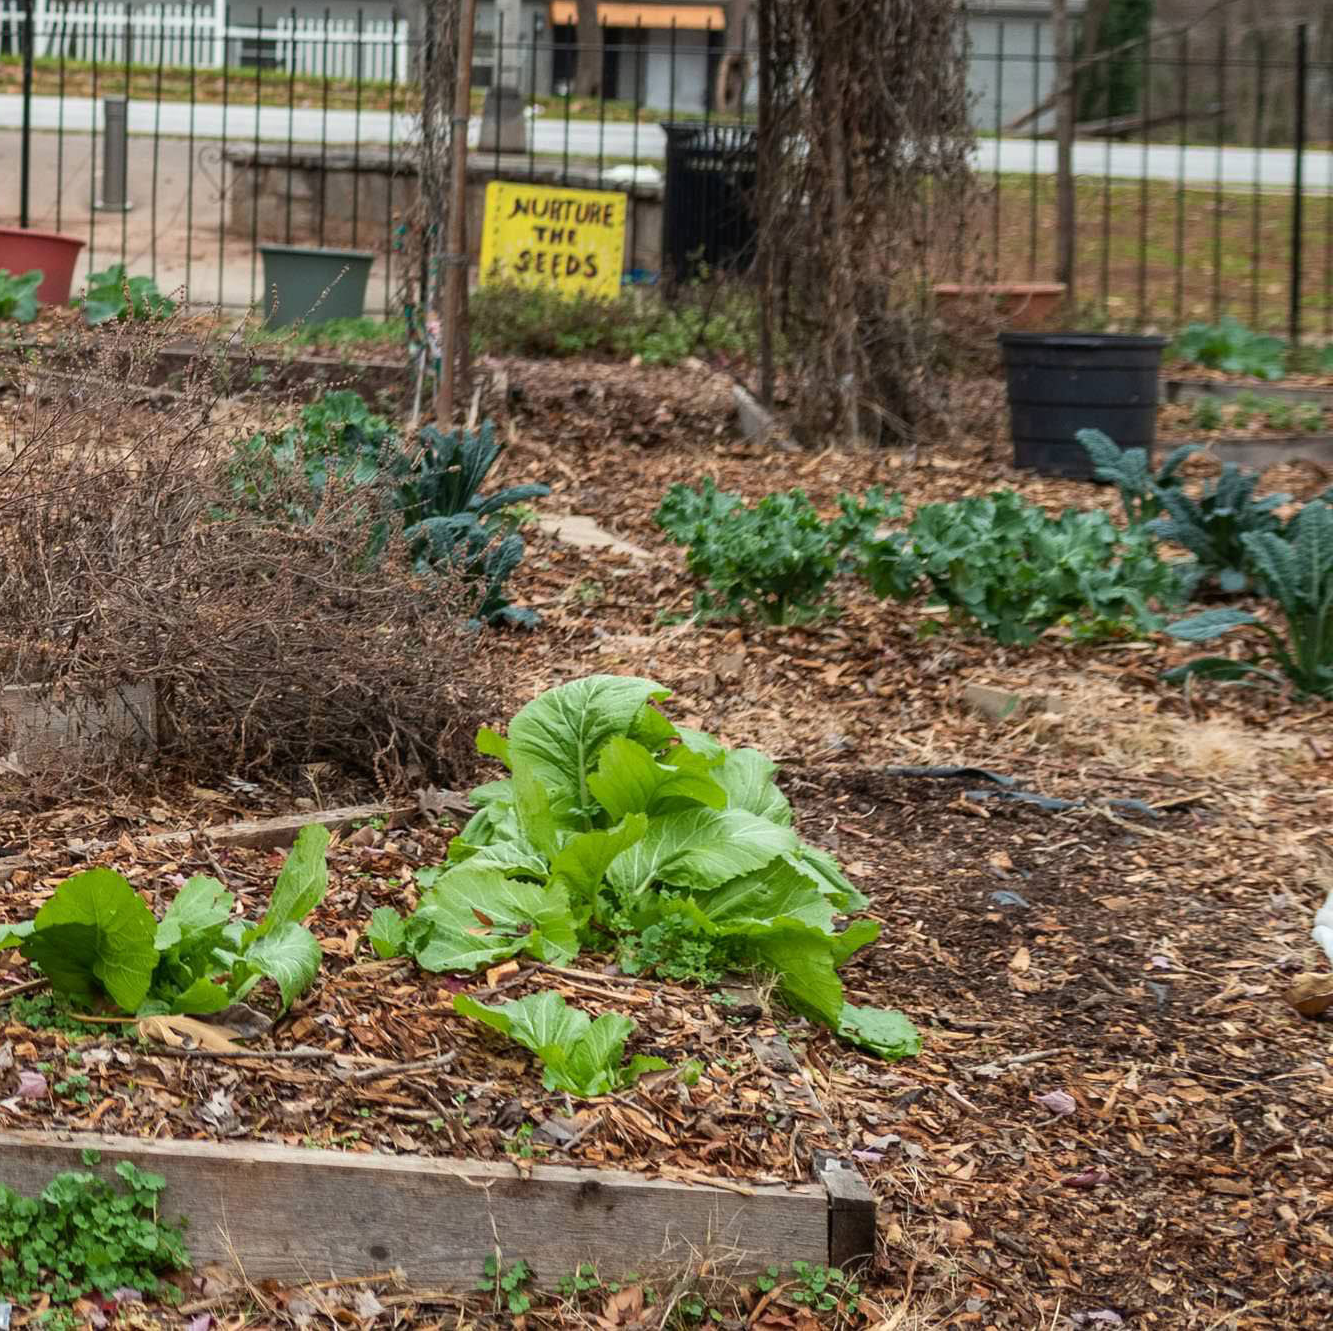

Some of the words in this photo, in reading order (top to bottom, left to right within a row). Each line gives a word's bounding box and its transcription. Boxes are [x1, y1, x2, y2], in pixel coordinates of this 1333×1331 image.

[509, 198, 615, 227] NURTURE
[533, 225, 577, 244] THE
[515, 250, 598, 280] SEEDS
